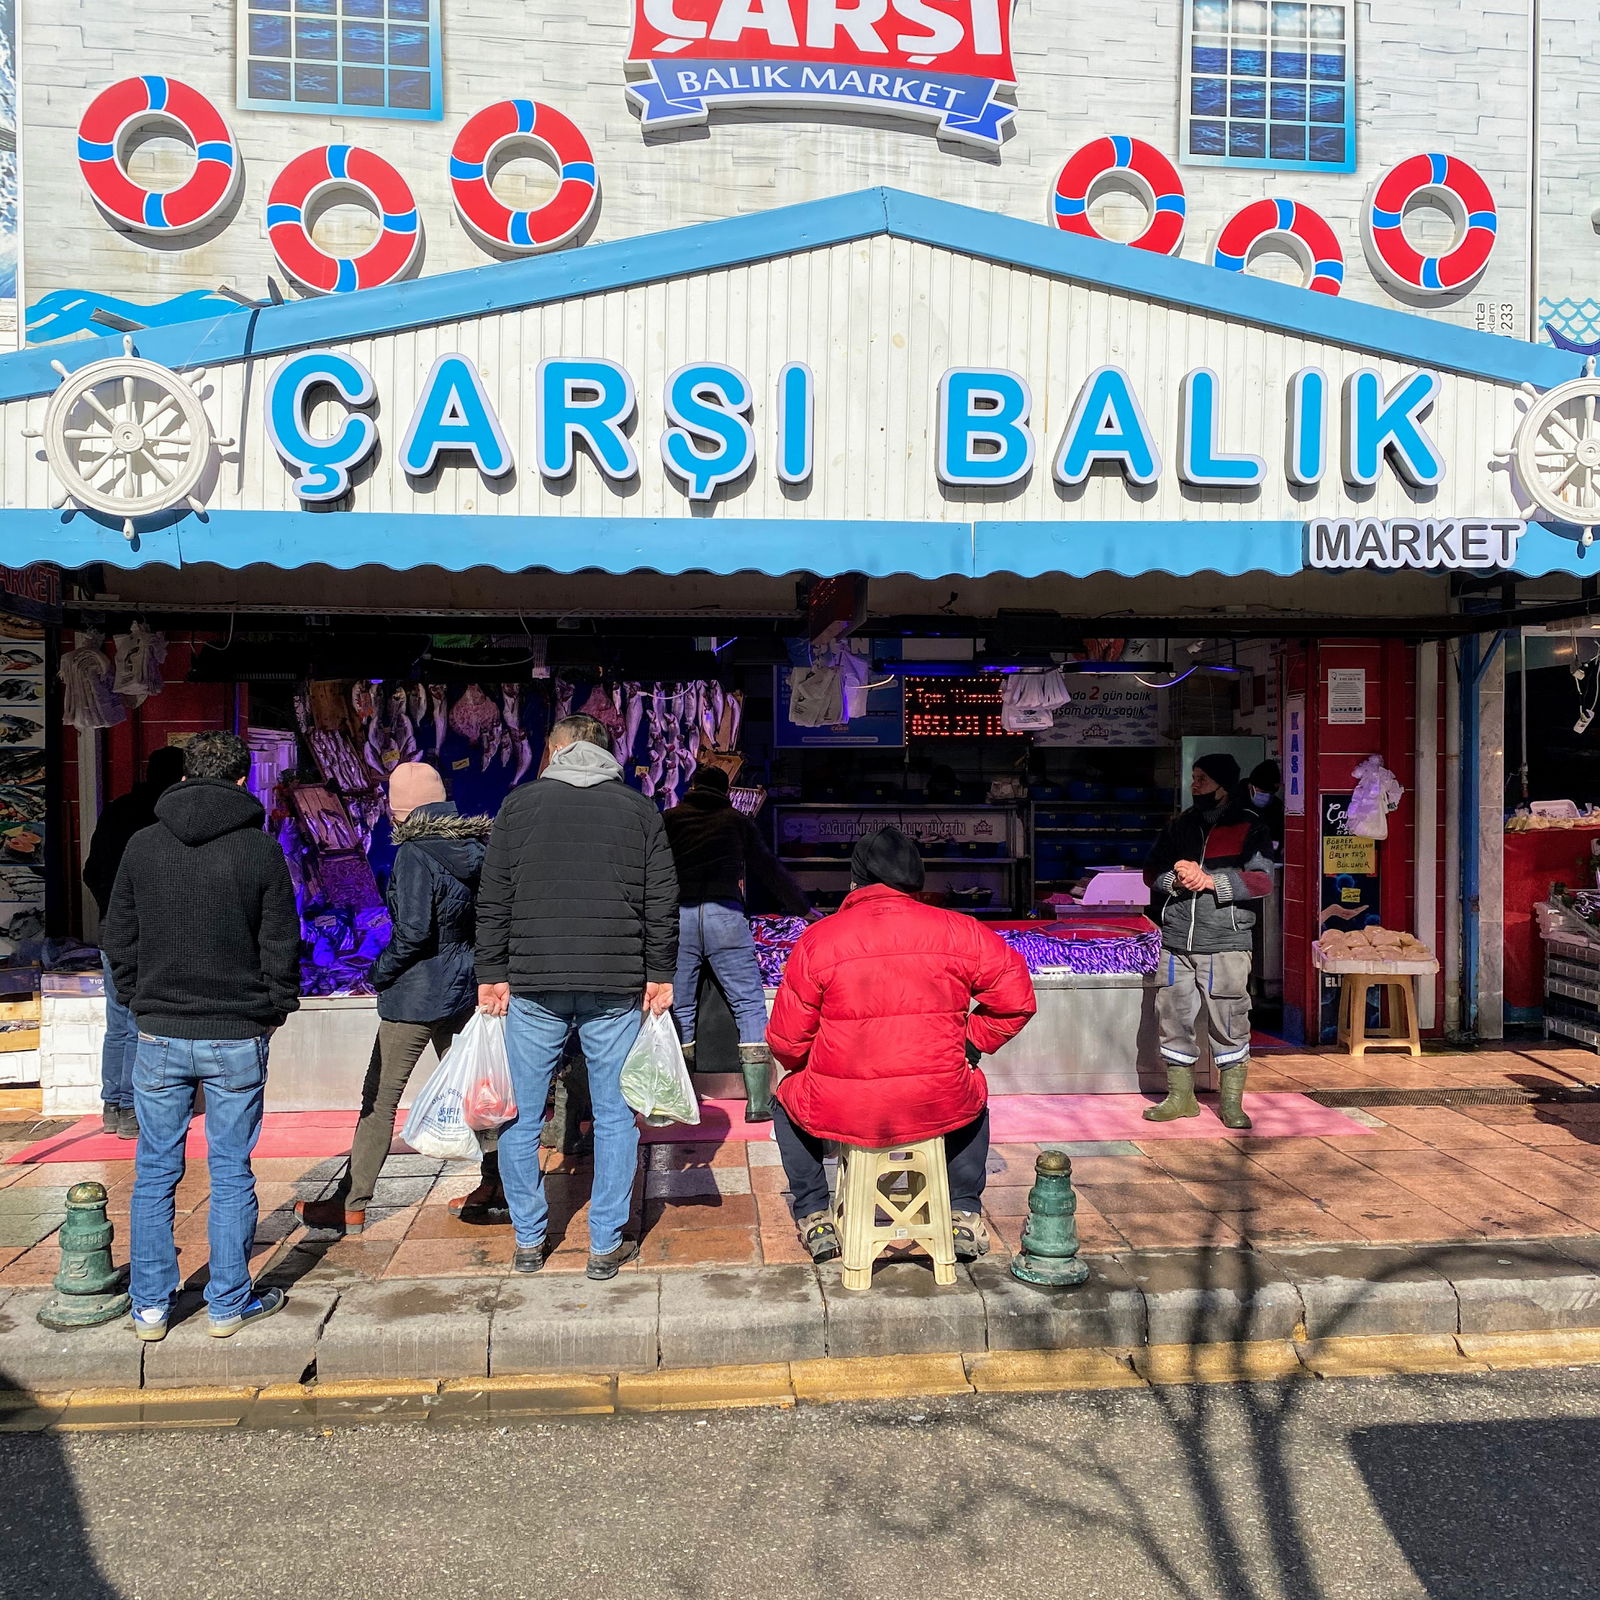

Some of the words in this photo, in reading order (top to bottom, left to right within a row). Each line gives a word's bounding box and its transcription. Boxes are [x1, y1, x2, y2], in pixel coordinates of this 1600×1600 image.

[642, 0, 1003, 65] ÇARŞI
[676, 66, 792, 94] BALIK
[800, 66, 966, 110] MARKET
[269, 353, 809, 497] ÇARŞI
[942, 369, 1441, 482] BALIK
[1315, 523, 1521, 561] MARKET
[1083, 706, 1112, 718] boyu
[1113, 706, 1145, 718] sağlık
[1088, 686, 1100, 701] 2
[1102, 691, 1123, 703] gün
[1125, 690, 1152, 701] balık
[1290, 712, 1300, 796] KASA
